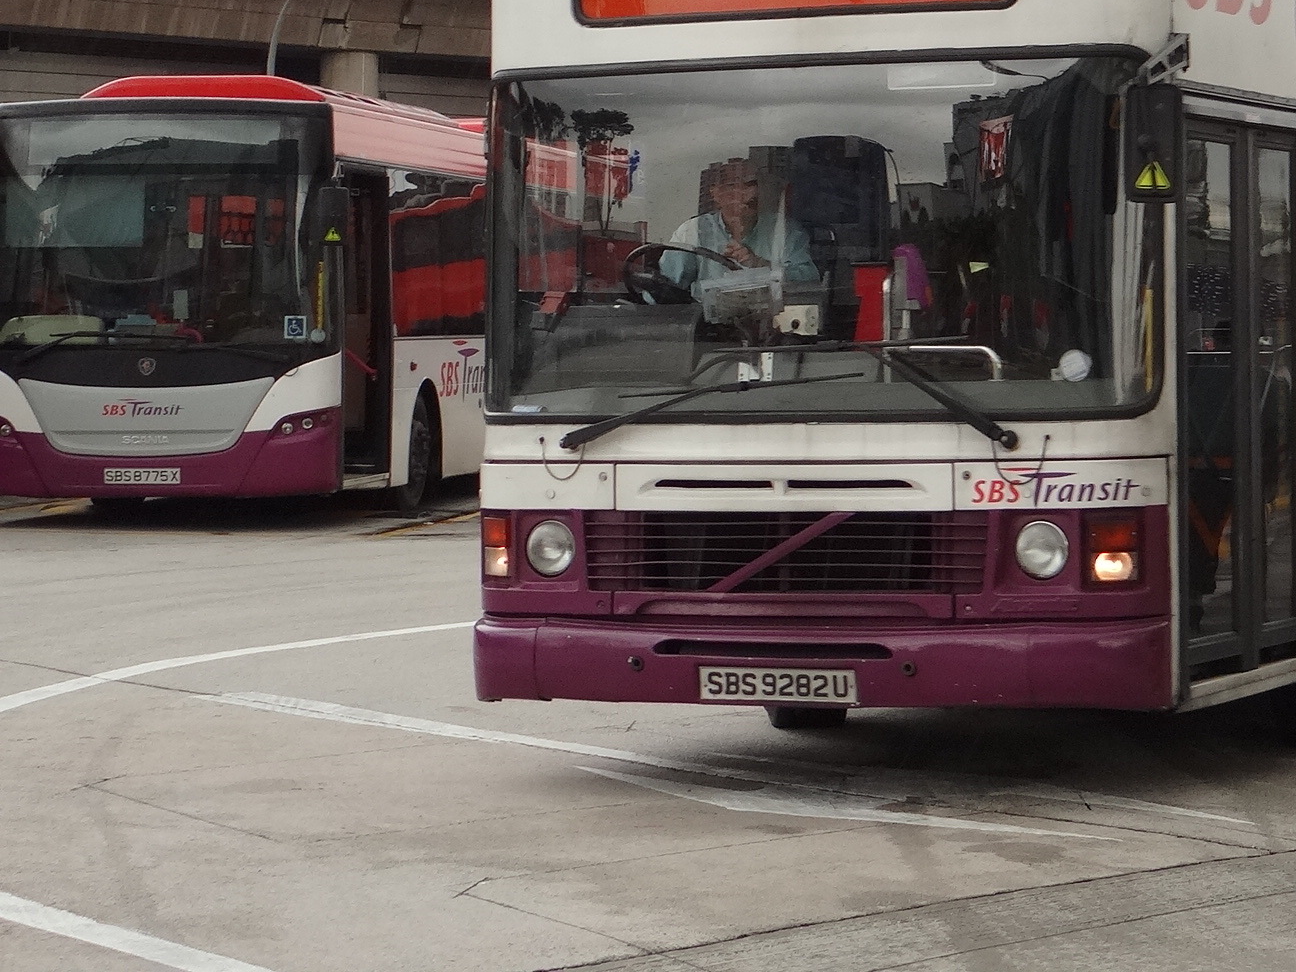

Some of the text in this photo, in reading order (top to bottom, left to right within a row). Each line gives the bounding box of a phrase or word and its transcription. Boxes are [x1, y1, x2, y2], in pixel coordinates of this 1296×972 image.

[439, 361, 460, 397] SBS
[102, 401, 185, 417] SBS Transit
[121, 435, 169, 445] SCANIA
[105, 470, 179, 482] SBS8775X
[972, 472, 1141, 507] SBS Transit
[707, 671, 849, 698] SBS9282U
